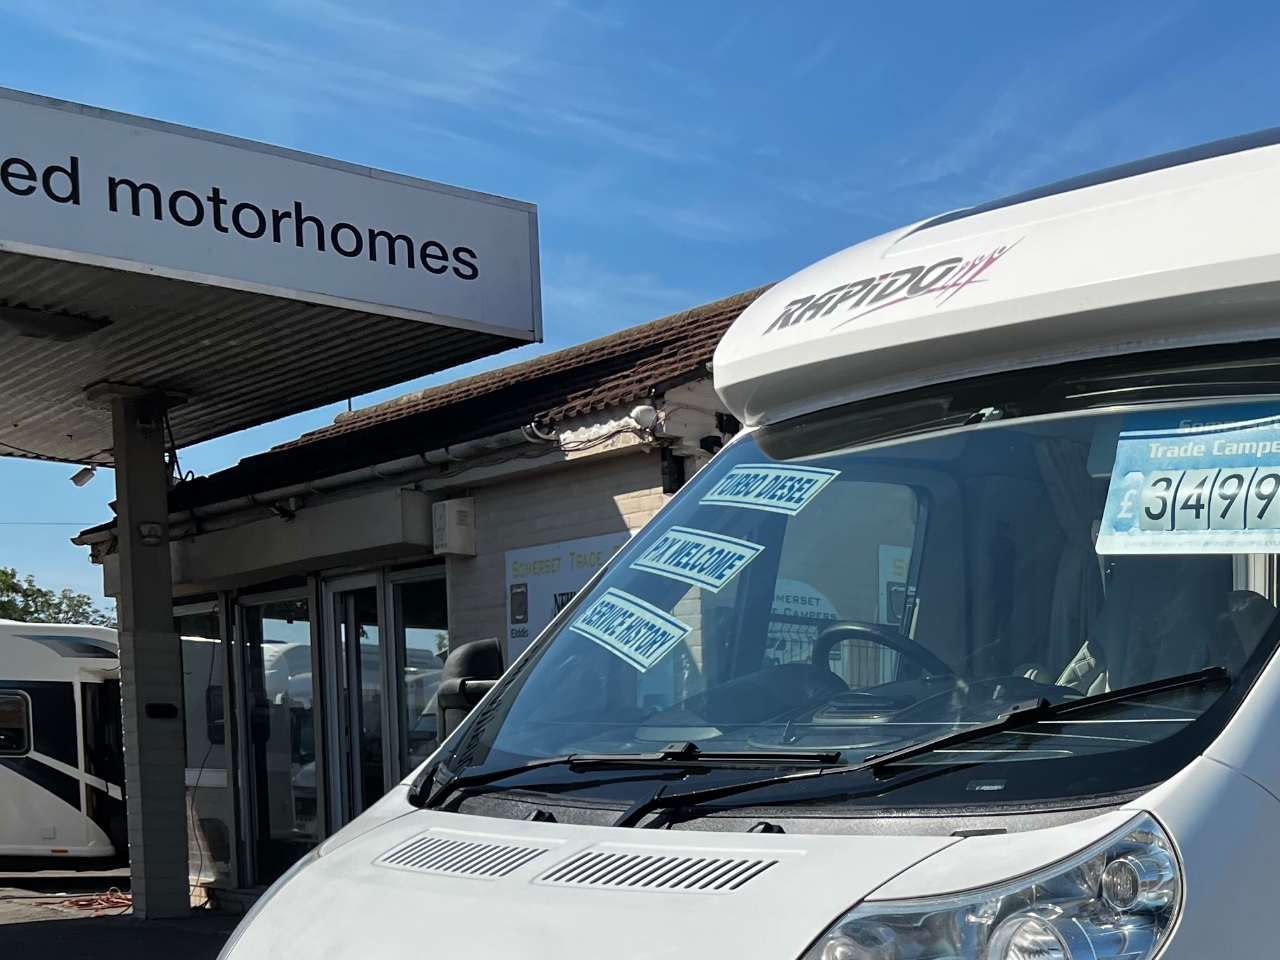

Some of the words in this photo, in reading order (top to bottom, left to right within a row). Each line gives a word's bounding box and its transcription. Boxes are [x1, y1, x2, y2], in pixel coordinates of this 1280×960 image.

[0, 156, 80, 206] ed
[108, 175, 480, 281] motorhomes
[761, 257, 964, 337] RAPIDO
[1149, 442, 1206, 460] Trade
[709, 473, 769, 498] TURBO
[753, 474, 820, 504] DIESEL
[662, 540, 746, 581] WELCOME
[580, 600, 636, 637] SERVICE
[614, 616, 676, 659] HISTORY
